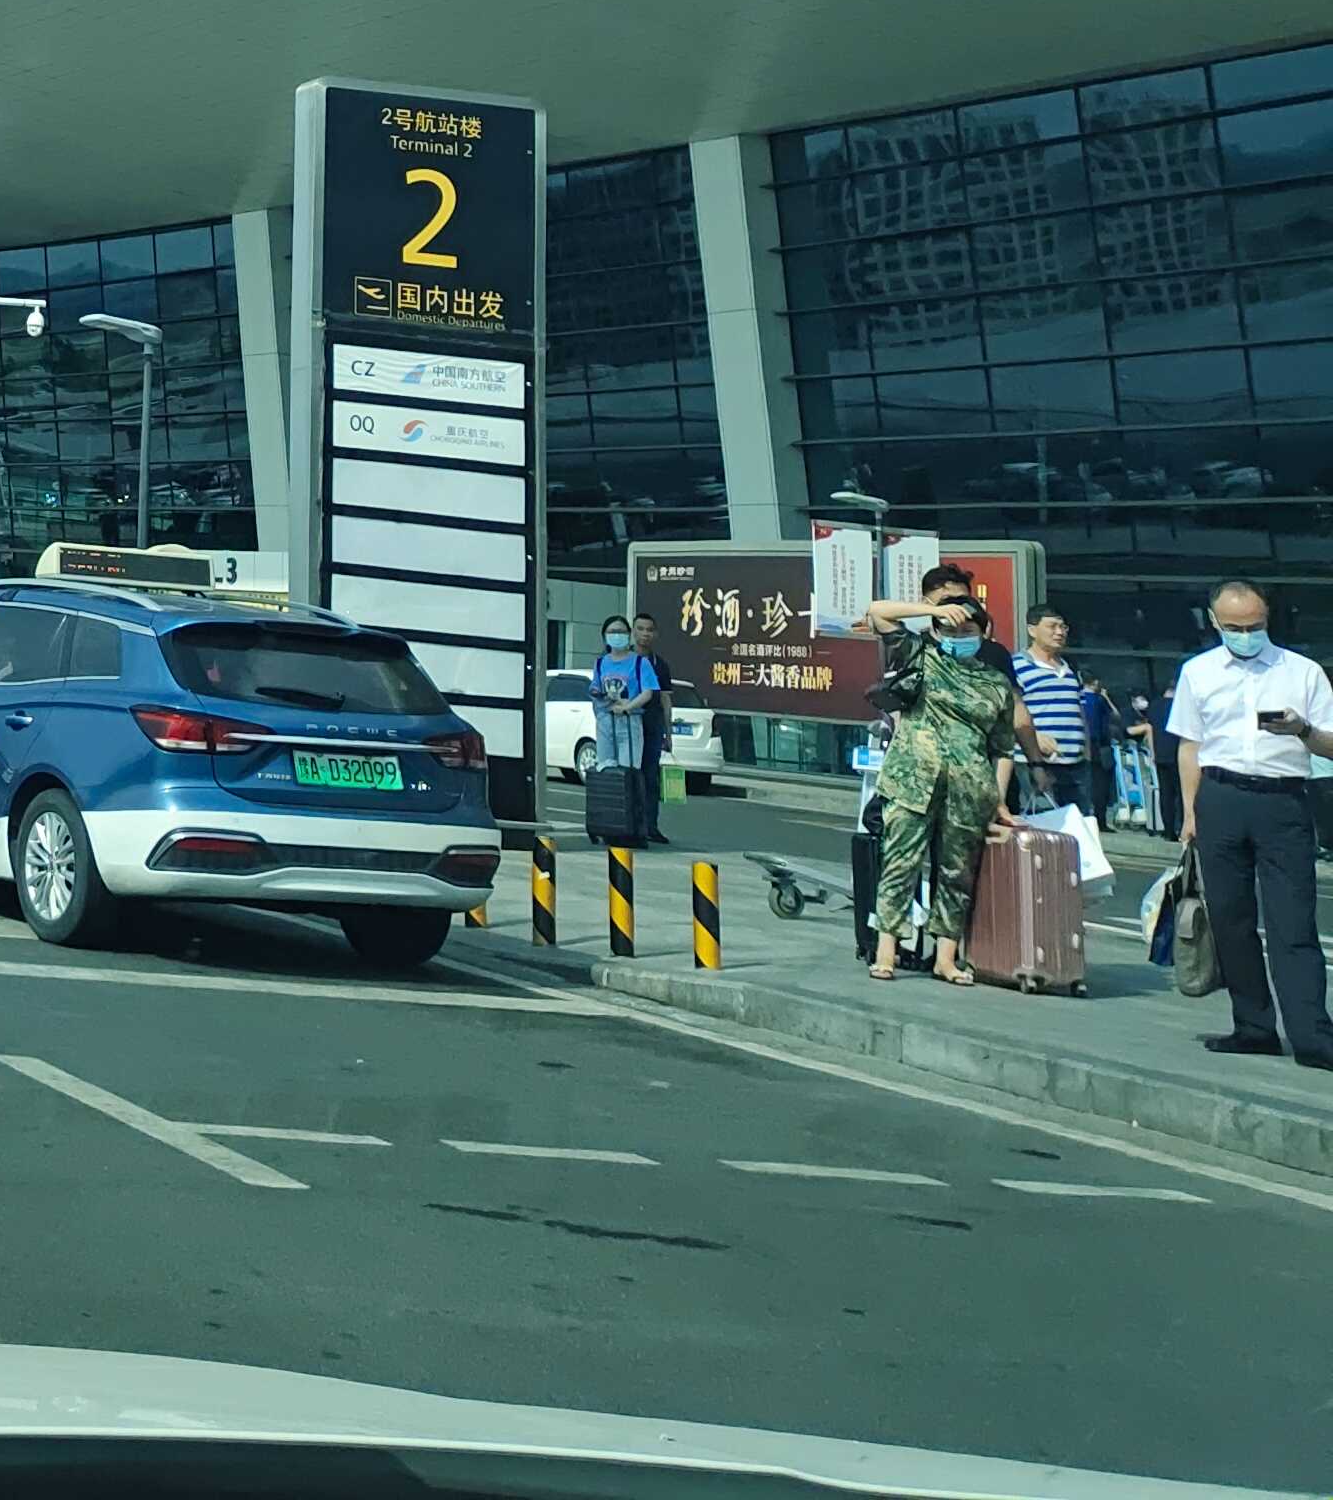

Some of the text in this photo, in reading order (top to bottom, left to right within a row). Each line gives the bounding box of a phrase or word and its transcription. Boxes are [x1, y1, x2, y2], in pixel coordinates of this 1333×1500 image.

[381, 107, 482, 139] 2号航站楼
[390, 135, 473, 158] Terminal 2
[402, 168, 458, 269] 2
[397, 282, 504, 320] 国内出发
[397, 310, 506, 331] Domestic Departures
[350, 360, 376, 377] CZ
[432, 365, 507, 384] 中国南方航空
[349, 414, 375, 434] OQ
[712, 661, 833, 693] 贵州三大酱香品牌
